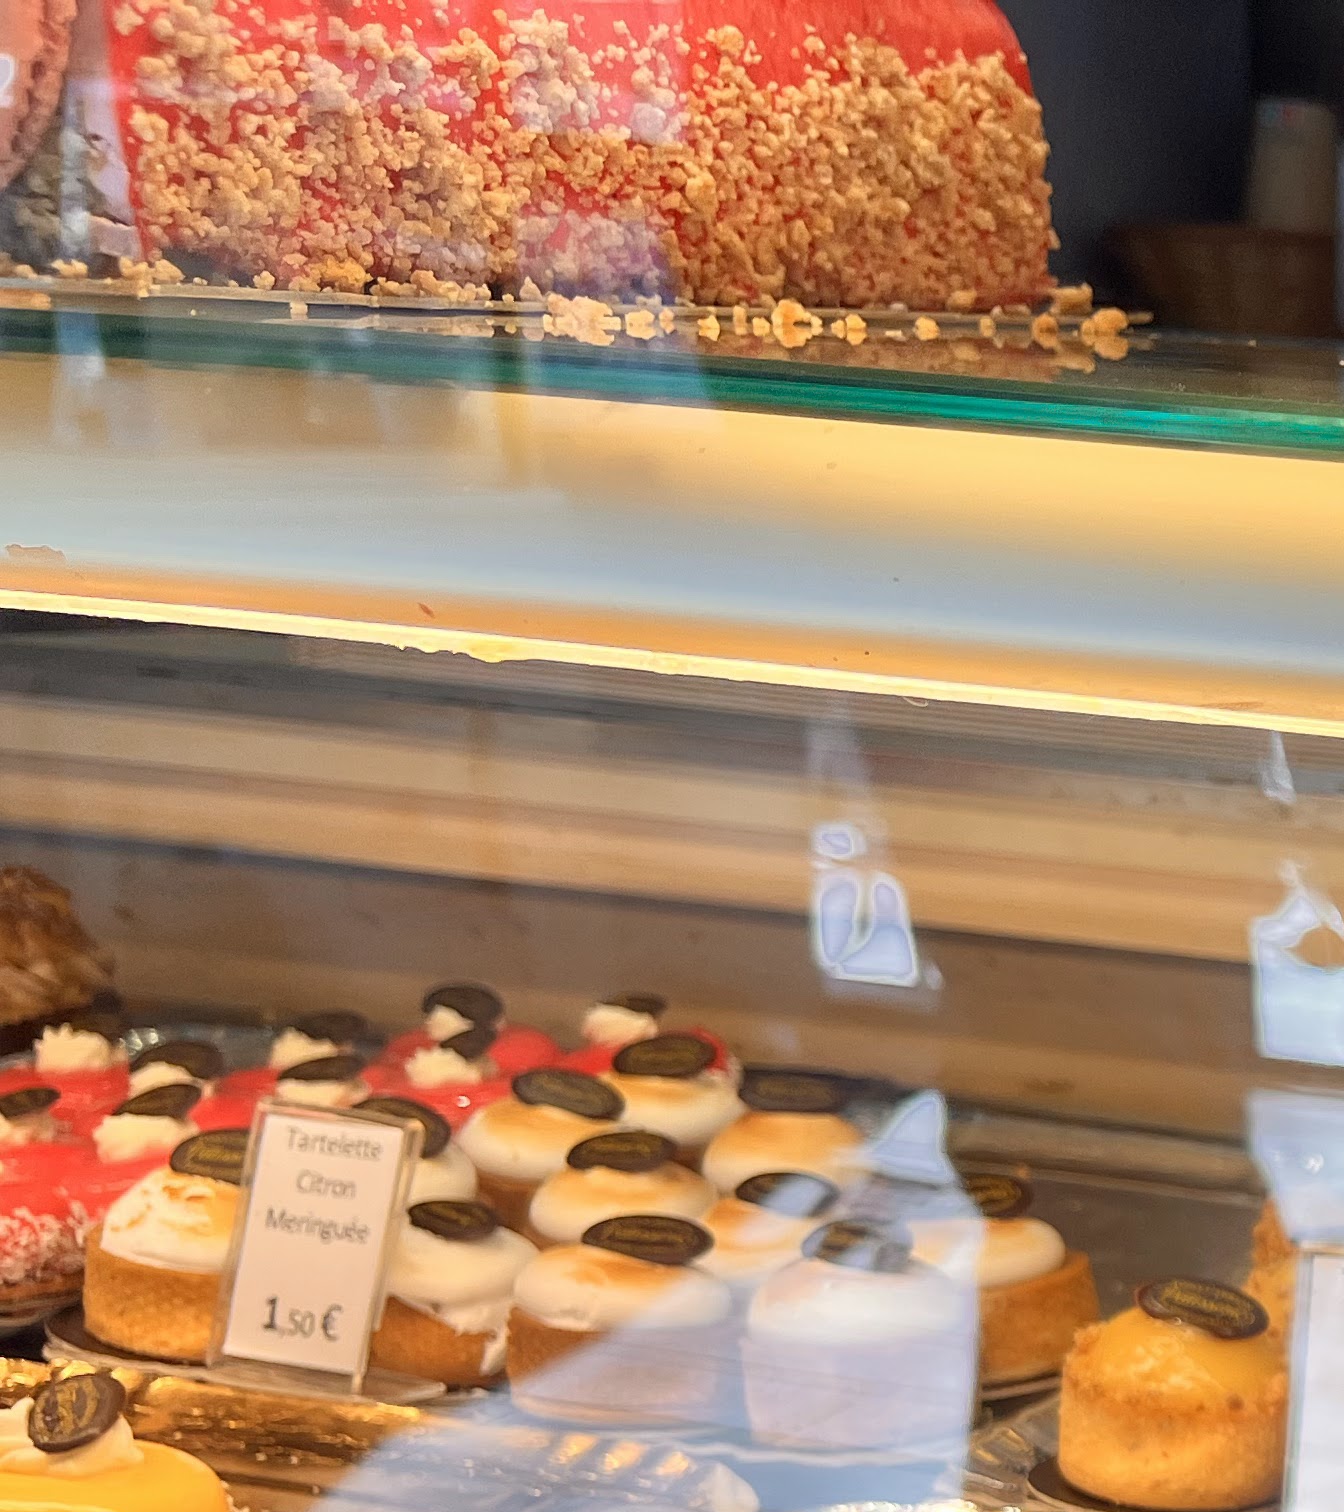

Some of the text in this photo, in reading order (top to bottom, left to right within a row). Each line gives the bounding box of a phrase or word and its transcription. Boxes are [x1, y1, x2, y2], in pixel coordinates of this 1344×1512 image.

[288, 1126, 383, 1161] Tartelette
[296, 1169, 357, 1200] Citron
[262, 1296, 343, 1342] 1,50 €
